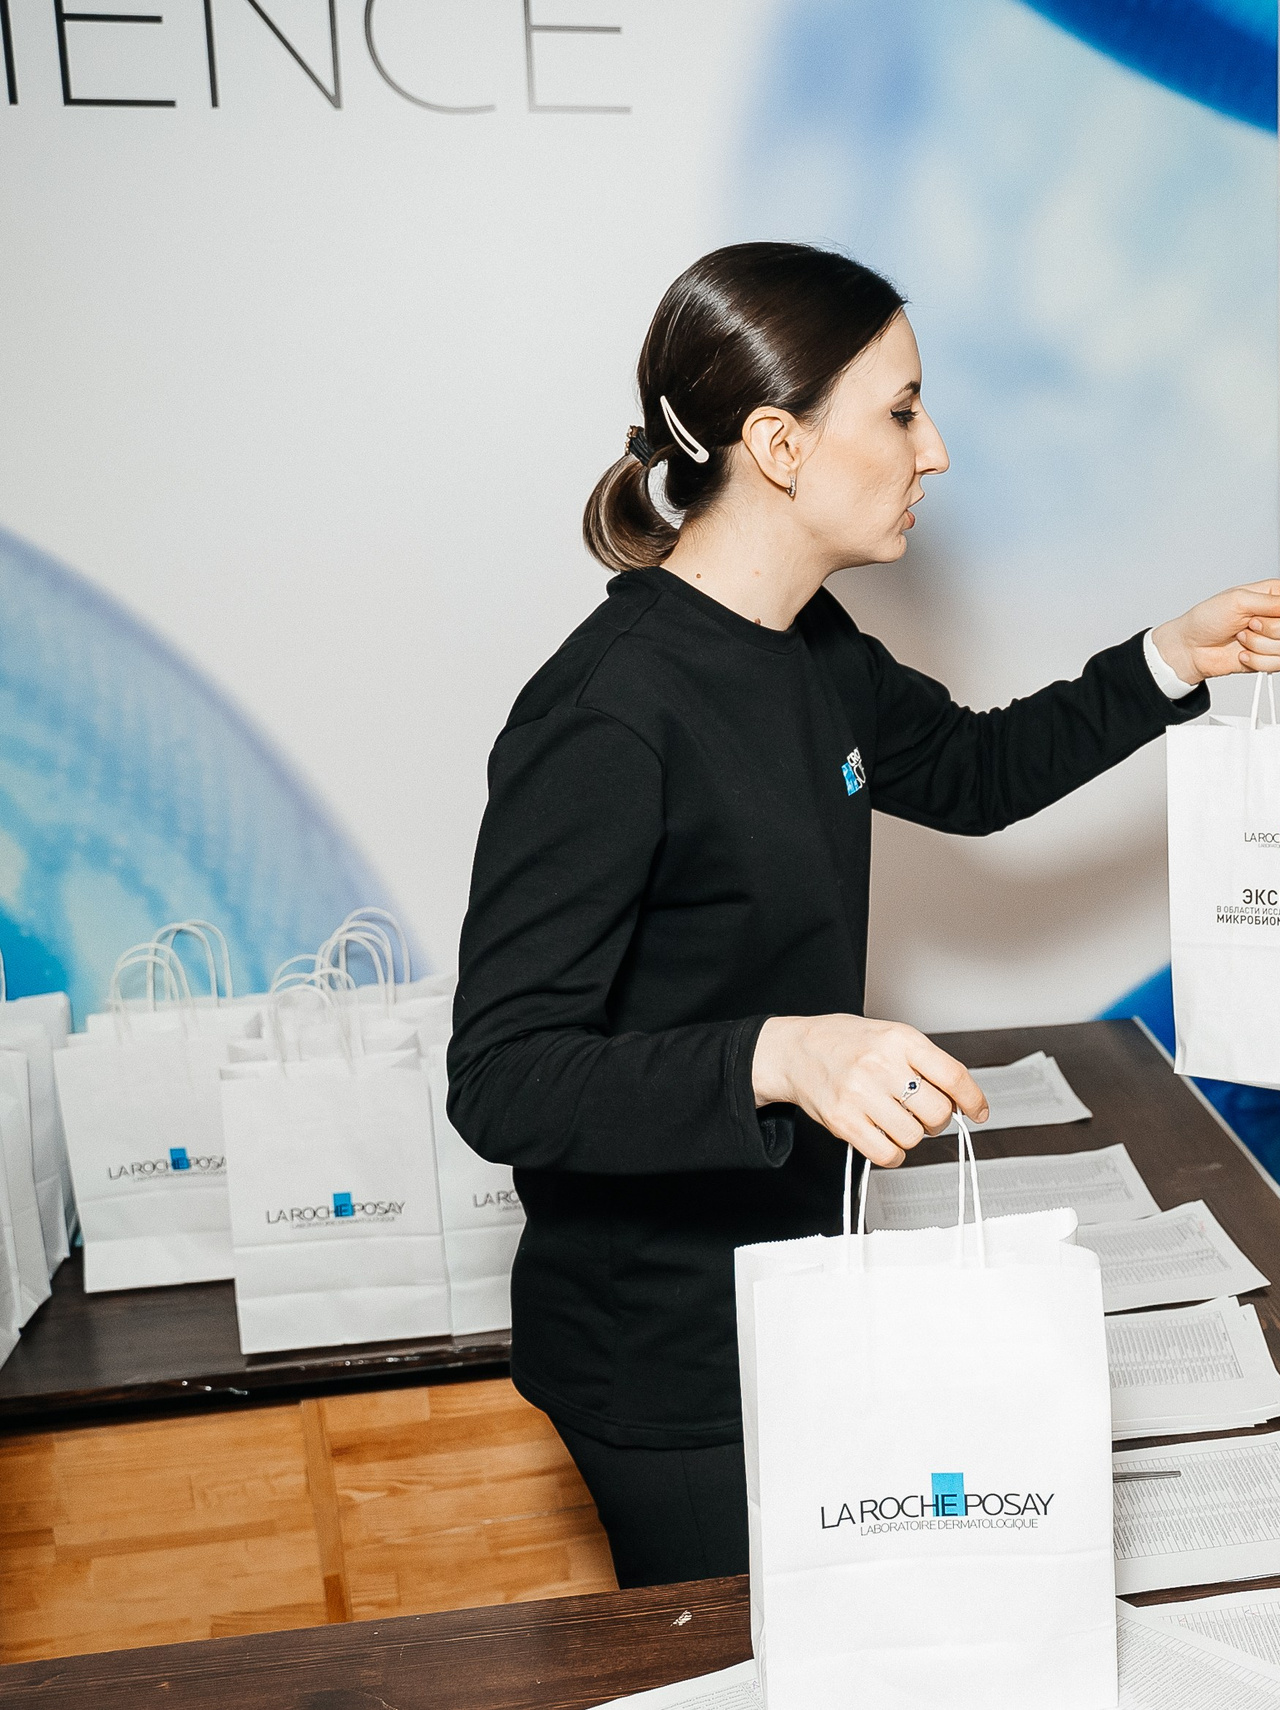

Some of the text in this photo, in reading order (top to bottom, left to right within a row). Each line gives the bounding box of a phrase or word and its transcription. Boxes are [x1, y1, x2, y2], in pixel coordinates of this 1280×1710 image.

[1244, 832, 1257, 842] LA
[1216, 905, 1222, 913] В
[1223, 905, 1260, 915] ОБЛАСТИ
[108, 1165, 128, 1180] LA
[188, 1155, 227, 1171] POSA
[266, 1209, 289, 1224] LA
[290, 1204, 350, 1221] ROCHE
[352, 1201, 406, 1216] POSAY
[820, 1493, 1055, 1530] LA ROCHE POSAY
[860, 1517, 1039, 1537] LABORATOIRE DERMATOLOGIQUE
